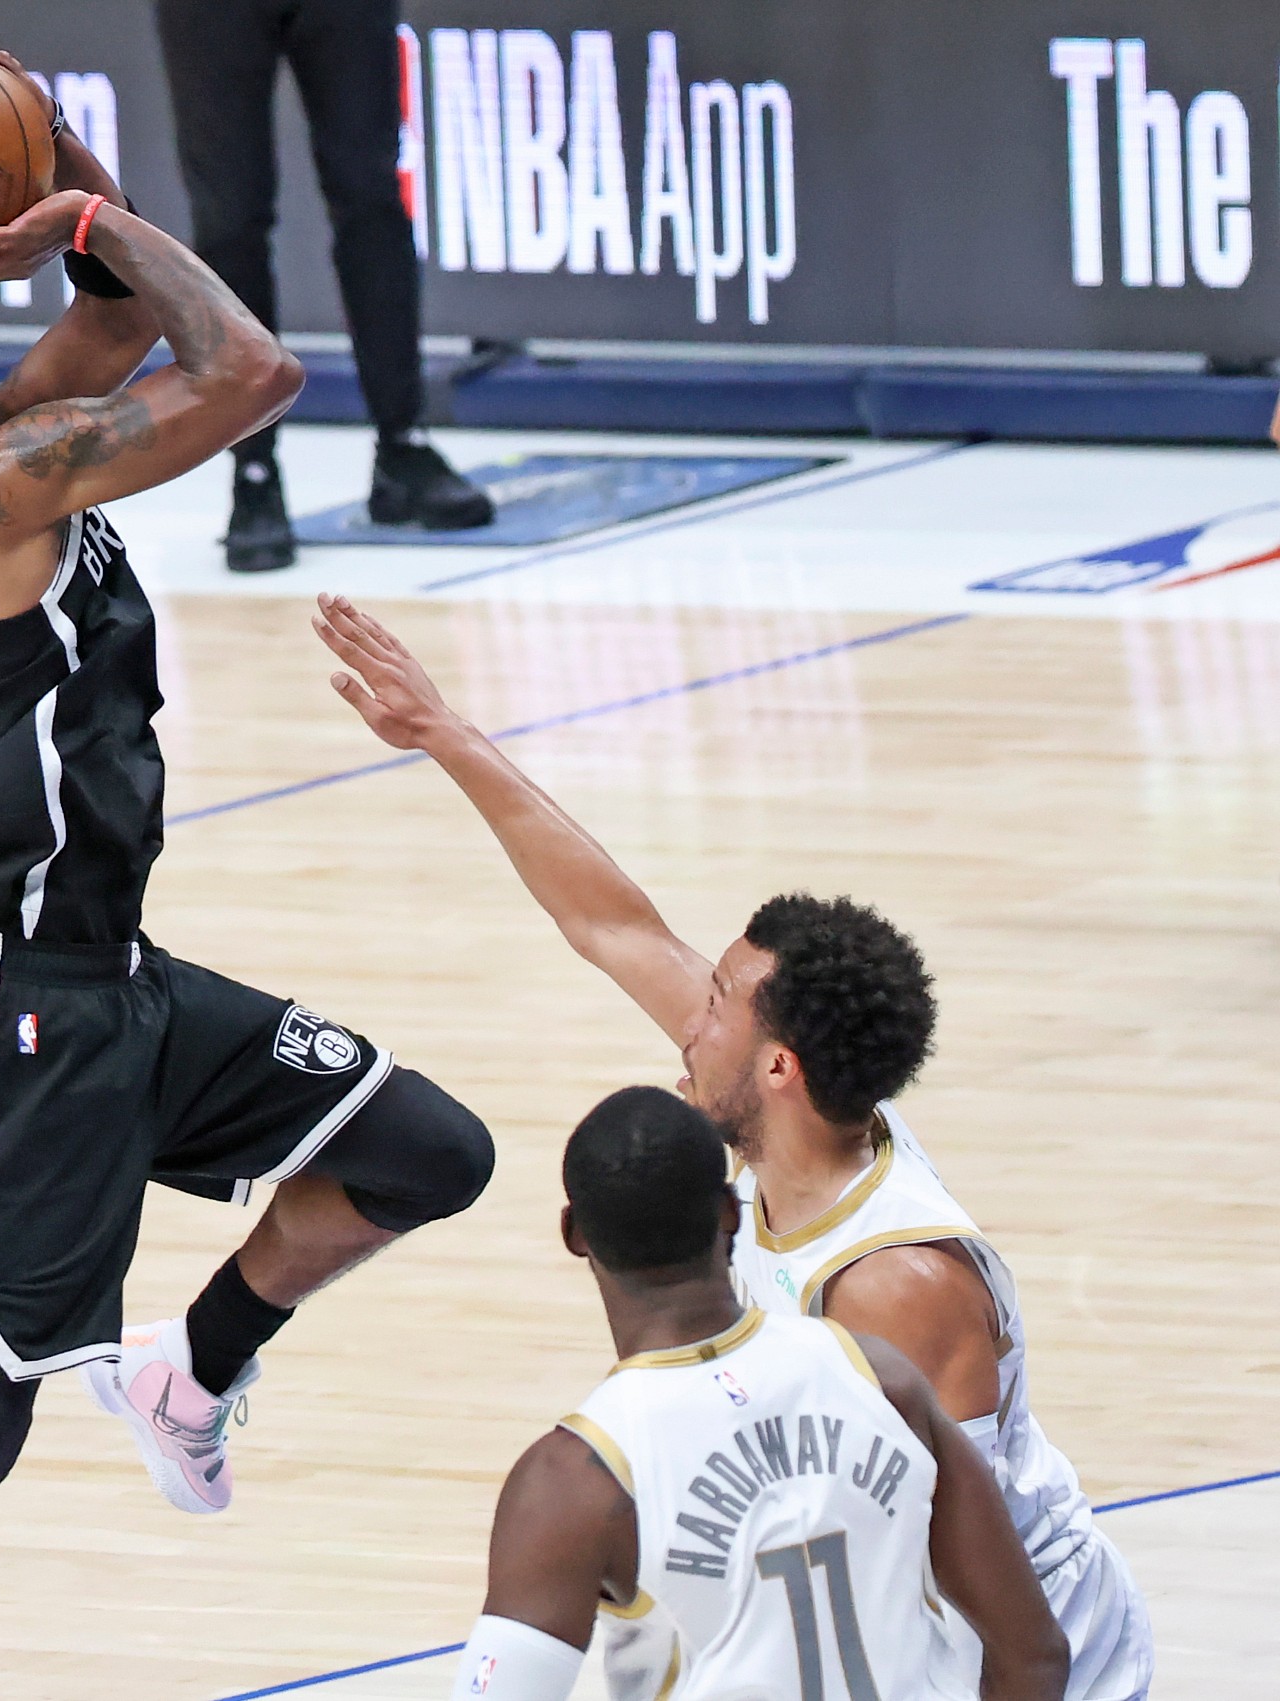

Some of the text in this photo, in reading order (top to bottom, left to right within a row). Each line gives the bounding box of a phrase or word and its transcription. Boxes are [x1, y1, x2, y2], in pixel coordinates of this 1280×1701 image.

[428, 27, 634, 275] NBA
[639, 30, 797, 325] App
[1048, 36, 1253, 289] The
[278, 1006, 325, 1067] NETS
[320, 1037, 348, 1059] B
[665, 1414, 910, 1580] HARDAWAY JR.
[754, 1530, 882, 1701] 11
